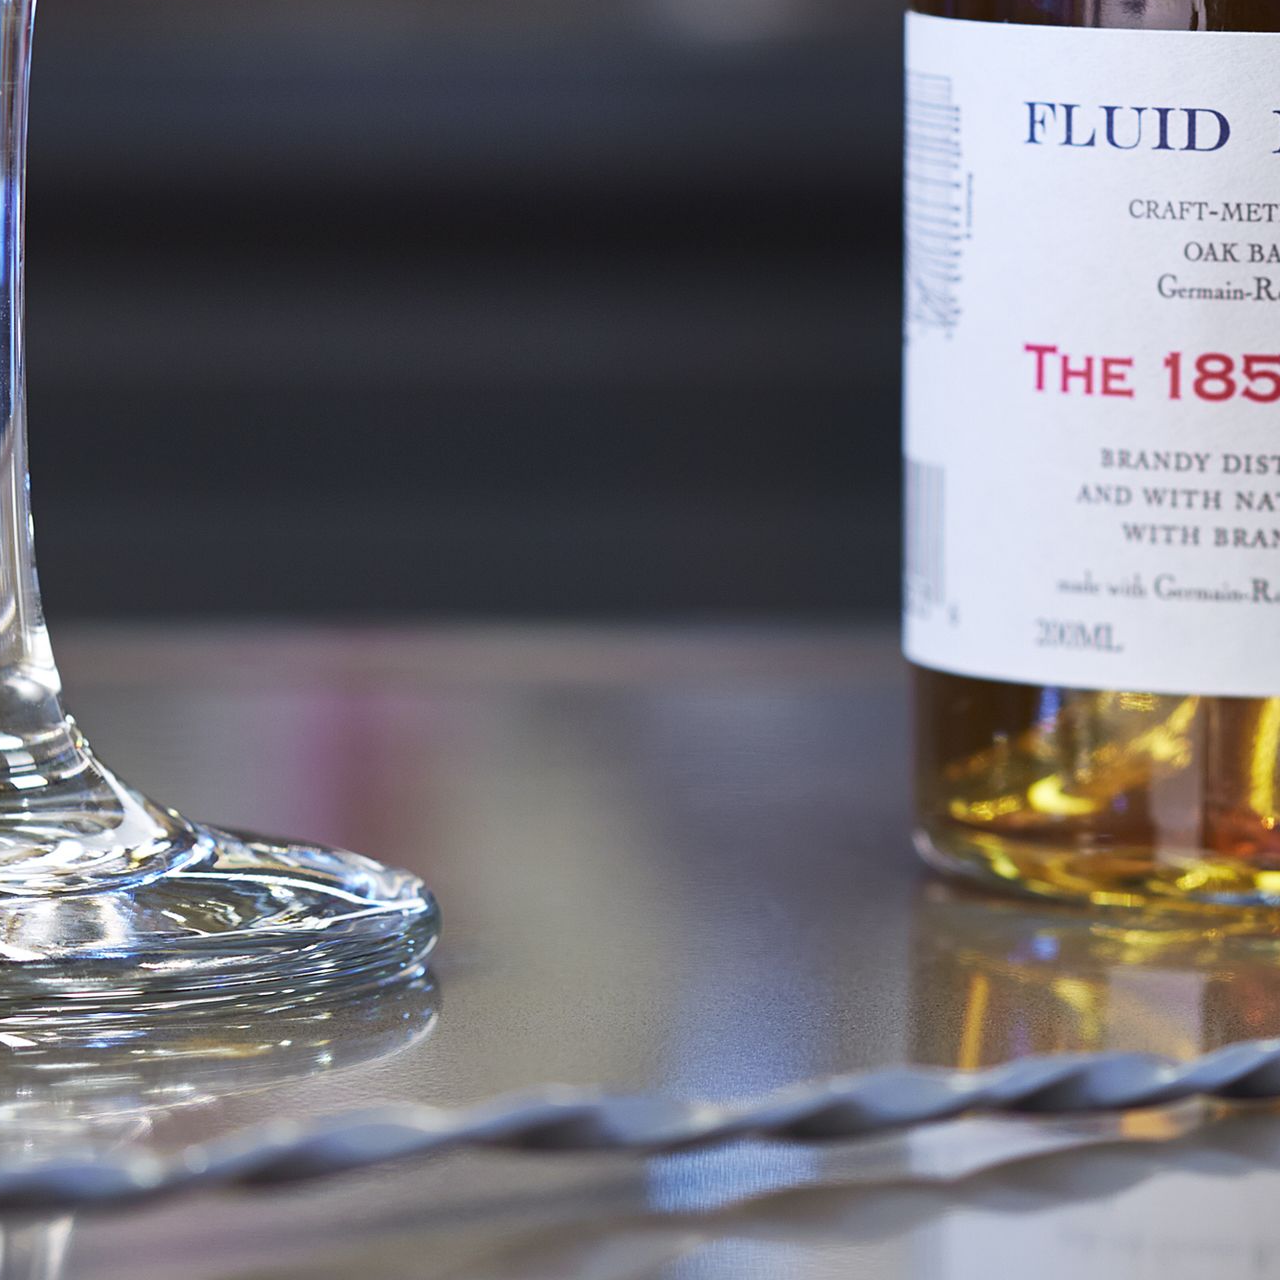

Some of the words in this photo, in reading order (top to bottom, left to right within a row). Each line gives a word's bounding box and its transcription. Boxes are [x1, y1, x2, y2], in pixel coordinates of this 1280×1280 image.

[1024, 102, 1230, 151] FLUID
[1184, 242, 1240, 263] OAK
[1024, 343, 1134, 399] THE
[1101, 448, 1211, 473] BRANDY
[1077, 484, 1133, 506] AND
[1142, 487, 1222, 511] WITH
[1122, 522, 1200, 546] WITH
[1106, 572, 1148, 599] with
